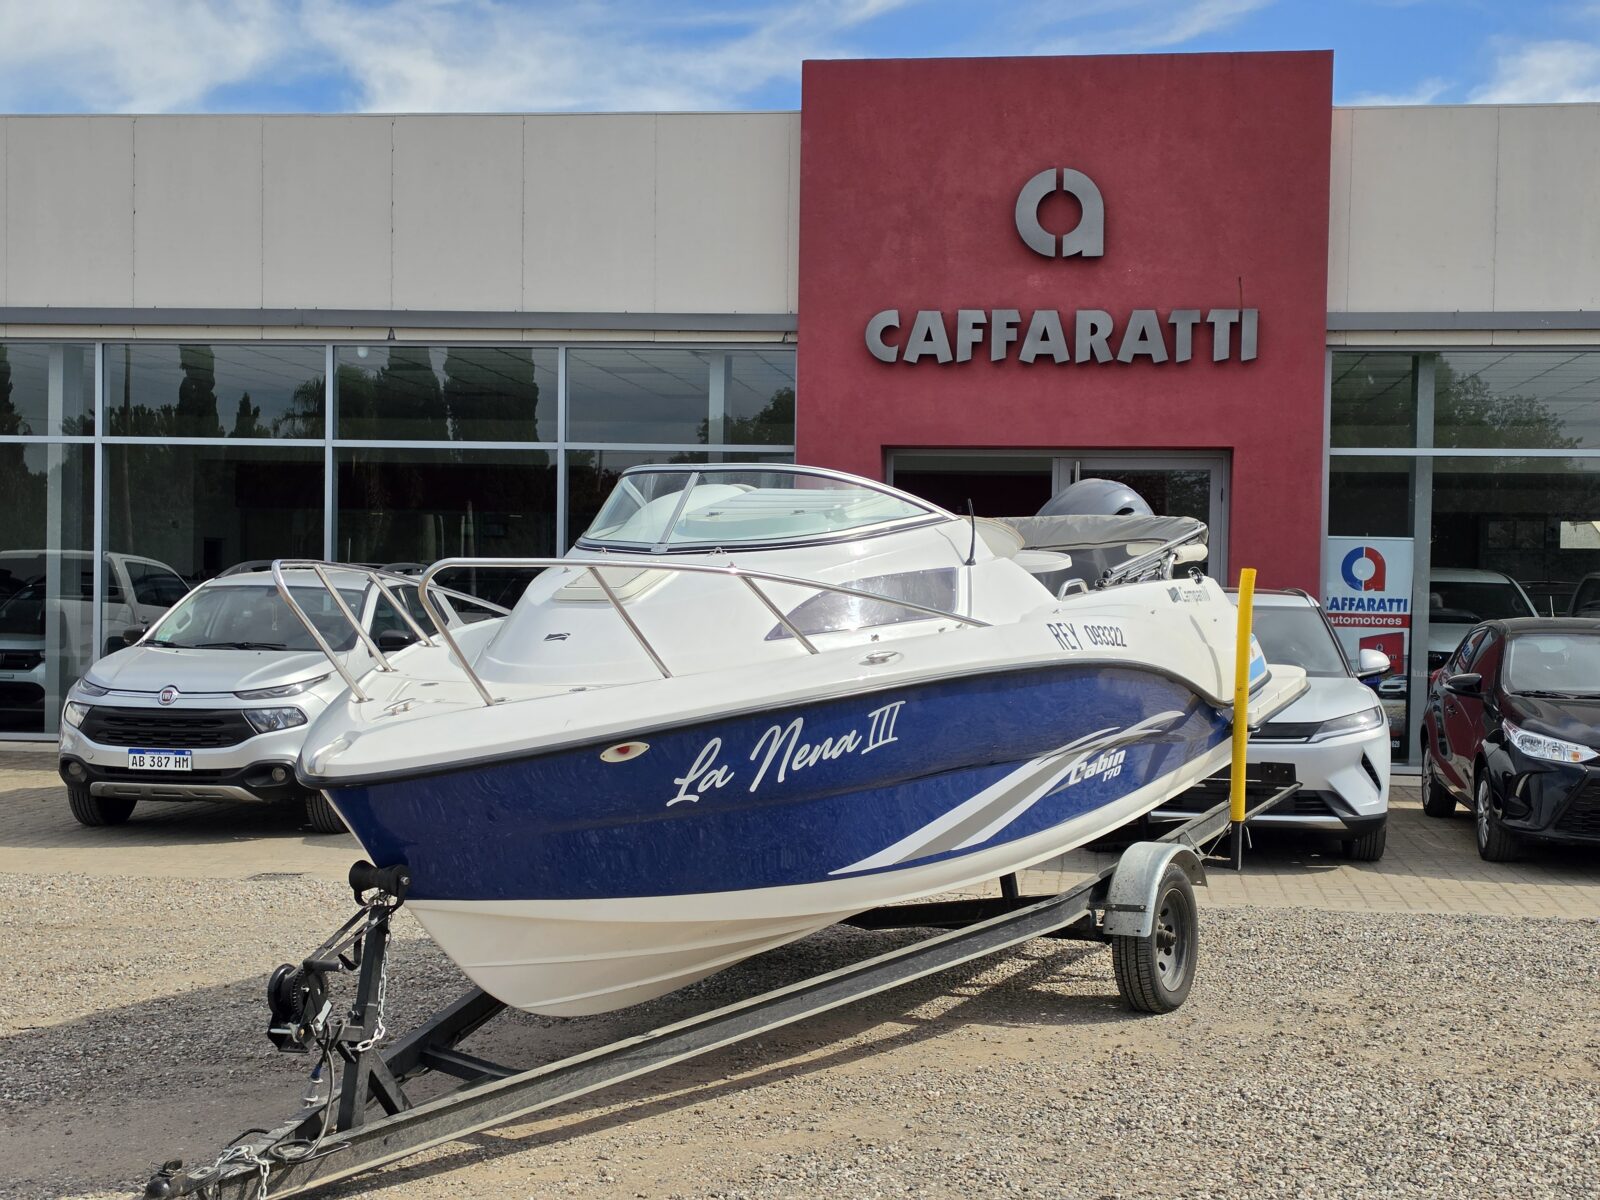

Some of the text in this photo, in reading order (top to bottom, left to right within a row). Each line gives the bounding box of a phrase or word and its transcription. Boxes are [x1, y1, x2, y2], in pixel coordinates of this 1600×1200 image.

[865, 309, 1259, 364] CAFFARATTI
[1327, 596, 1408, 612] AFFARATTI
[1046, 622, 1127, 650] REY 093322
[131, 755, 189, 769] AB 387 HM
[666, 700, 906, 807] La Nena III
[1068, 748, 1126, 785] Cabin
[1102, 764, 1122, 782] 170
